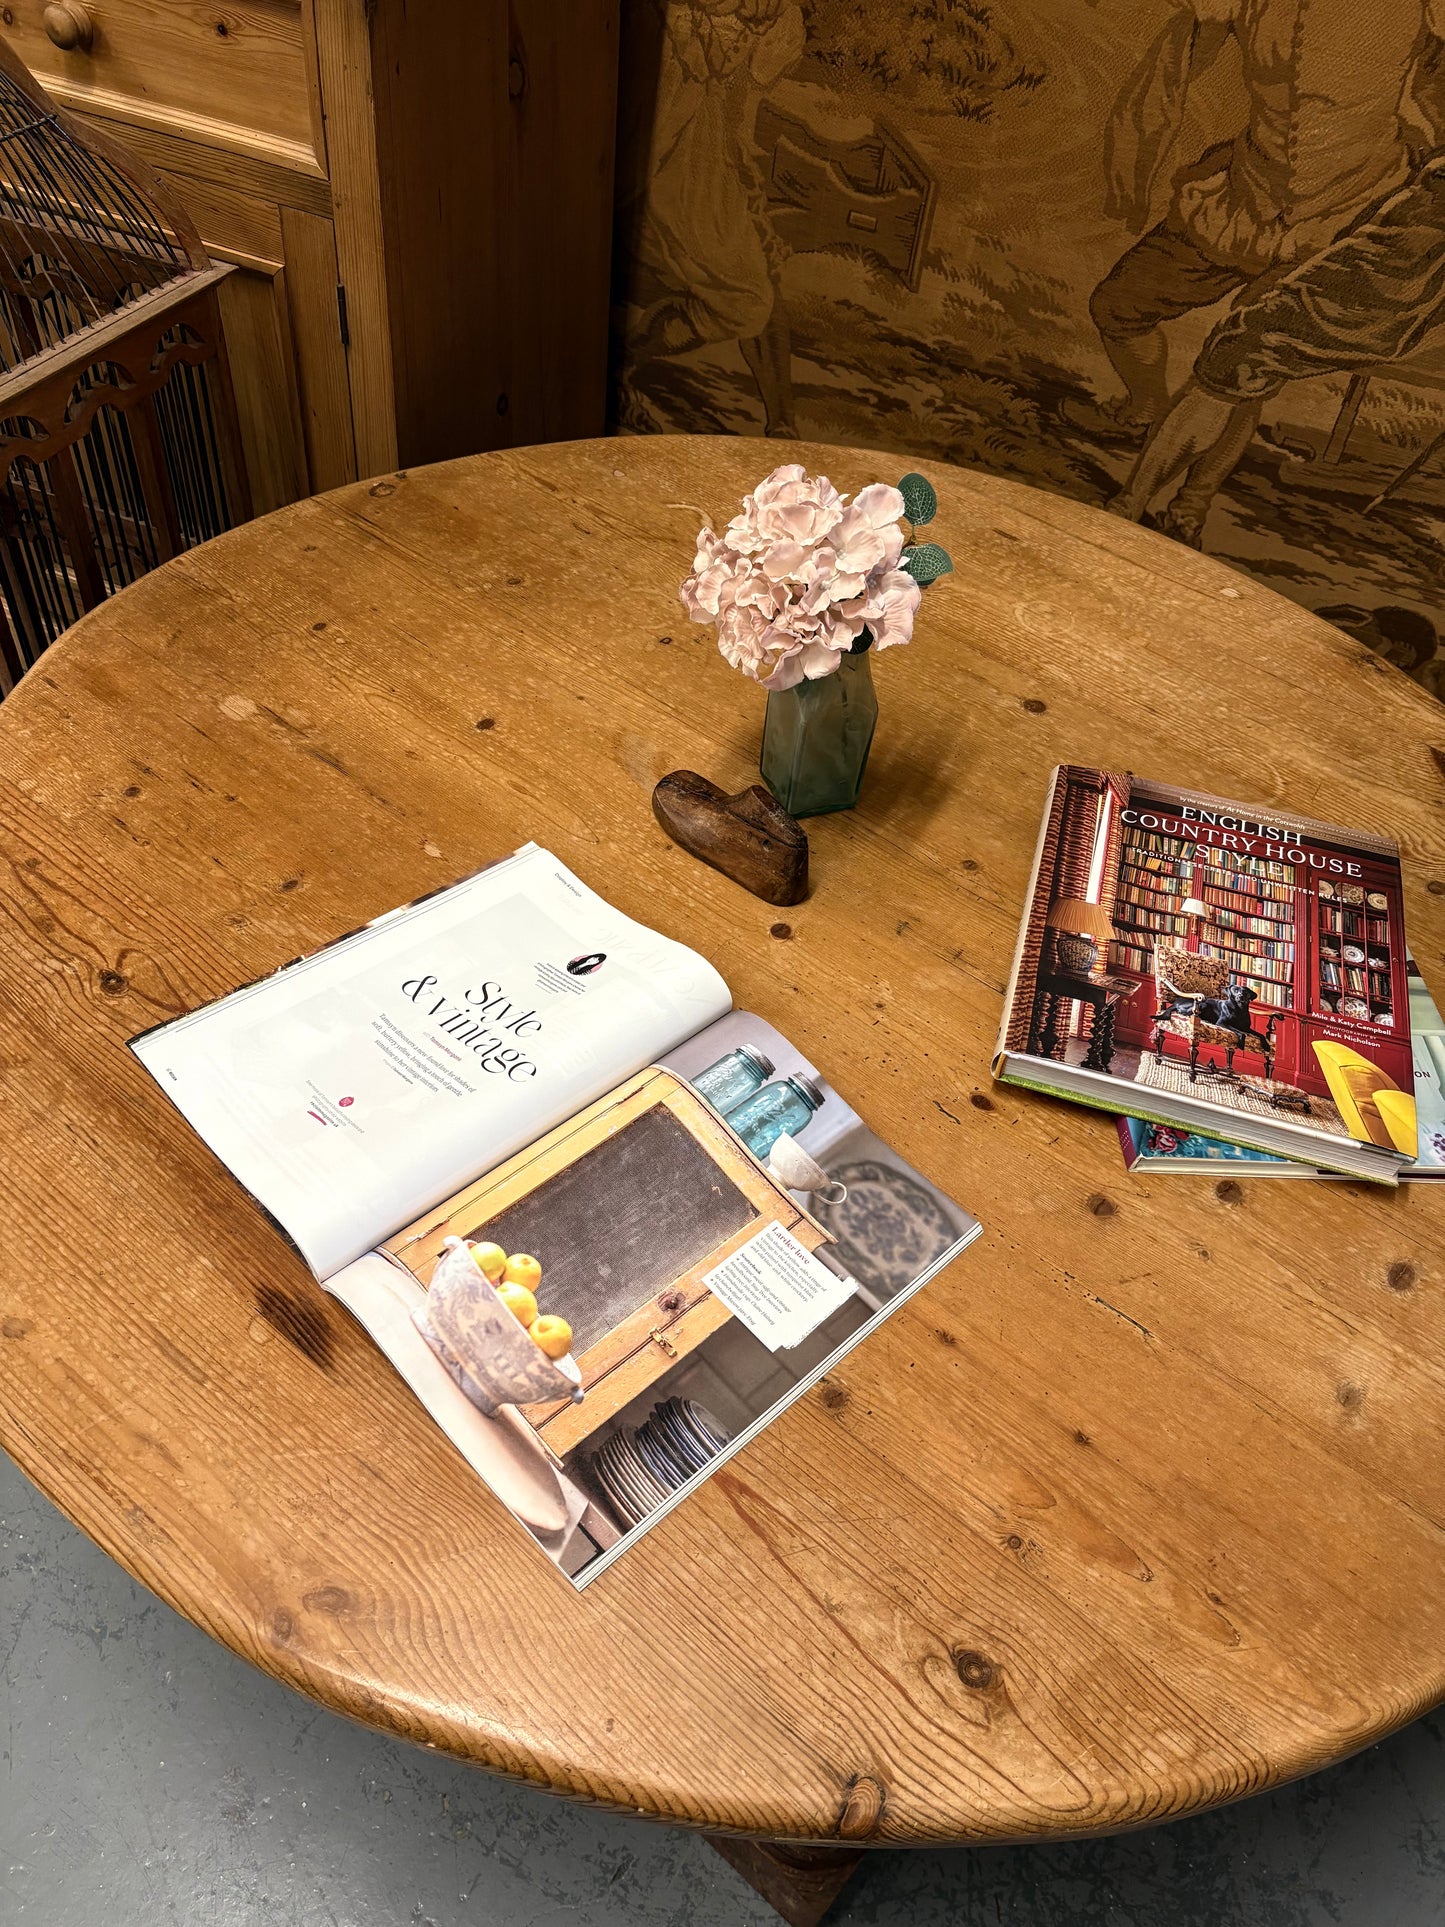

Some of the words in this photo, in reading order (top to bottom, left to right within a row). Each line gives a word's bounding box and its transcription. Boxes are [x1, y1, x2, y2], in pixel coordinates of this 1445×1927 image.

[1182, 806, 1302, 846] ENGLISH
[1197, 800, 1218, 809] creators
[1236, 808, 1255, 817] Home
[1274, 818, 1306, 830] Cotswolds
[1121, 810, 1257, 852] COUNTRY
[1265, 843, 1362, 878] HOUSE
[1196, 844, 1283, 876] STYLE
[1238, 874, 1258, 882] AND
[1260, 879, 1316, 896] UNWRITTEN
[1318, 892, 1348, 904] RULES
[465, 981, 542, 1038] Style
[1312, 1012, 1328, 1021] Milo
[1338, 1018, 1355, 1028] Katy
[1356, 1022, 1392, 1036] Campbell
[401, 975, 438, 1004] &
[428, 996, 537, 1083] vintage
[1322, 1029, 1342, 1039] Mark
[1344, 1034, 1381, 1048] Nicholson
[1326, 1025, 1368, 1038] PHOTOGRAPHY
[374, 1039, 395, 1058] sunshine
[405, 1065, 422, 1079] vintage
[379, 1013, 398, 1032] Tamsyn
[394, 1030, 416, 1048] discovers
[453, 1076, 470, 1089] shades
[380, 1029, 398, 1046] buttery
[410, 1056, 430, 1073] bringing
[445, 1085, 463, 1097] gentle
[740, 1253, 762, 1275] Sourcebook
[772, 1226, 796, 1250] Larder
[795, 1249, 810, 1264] love
